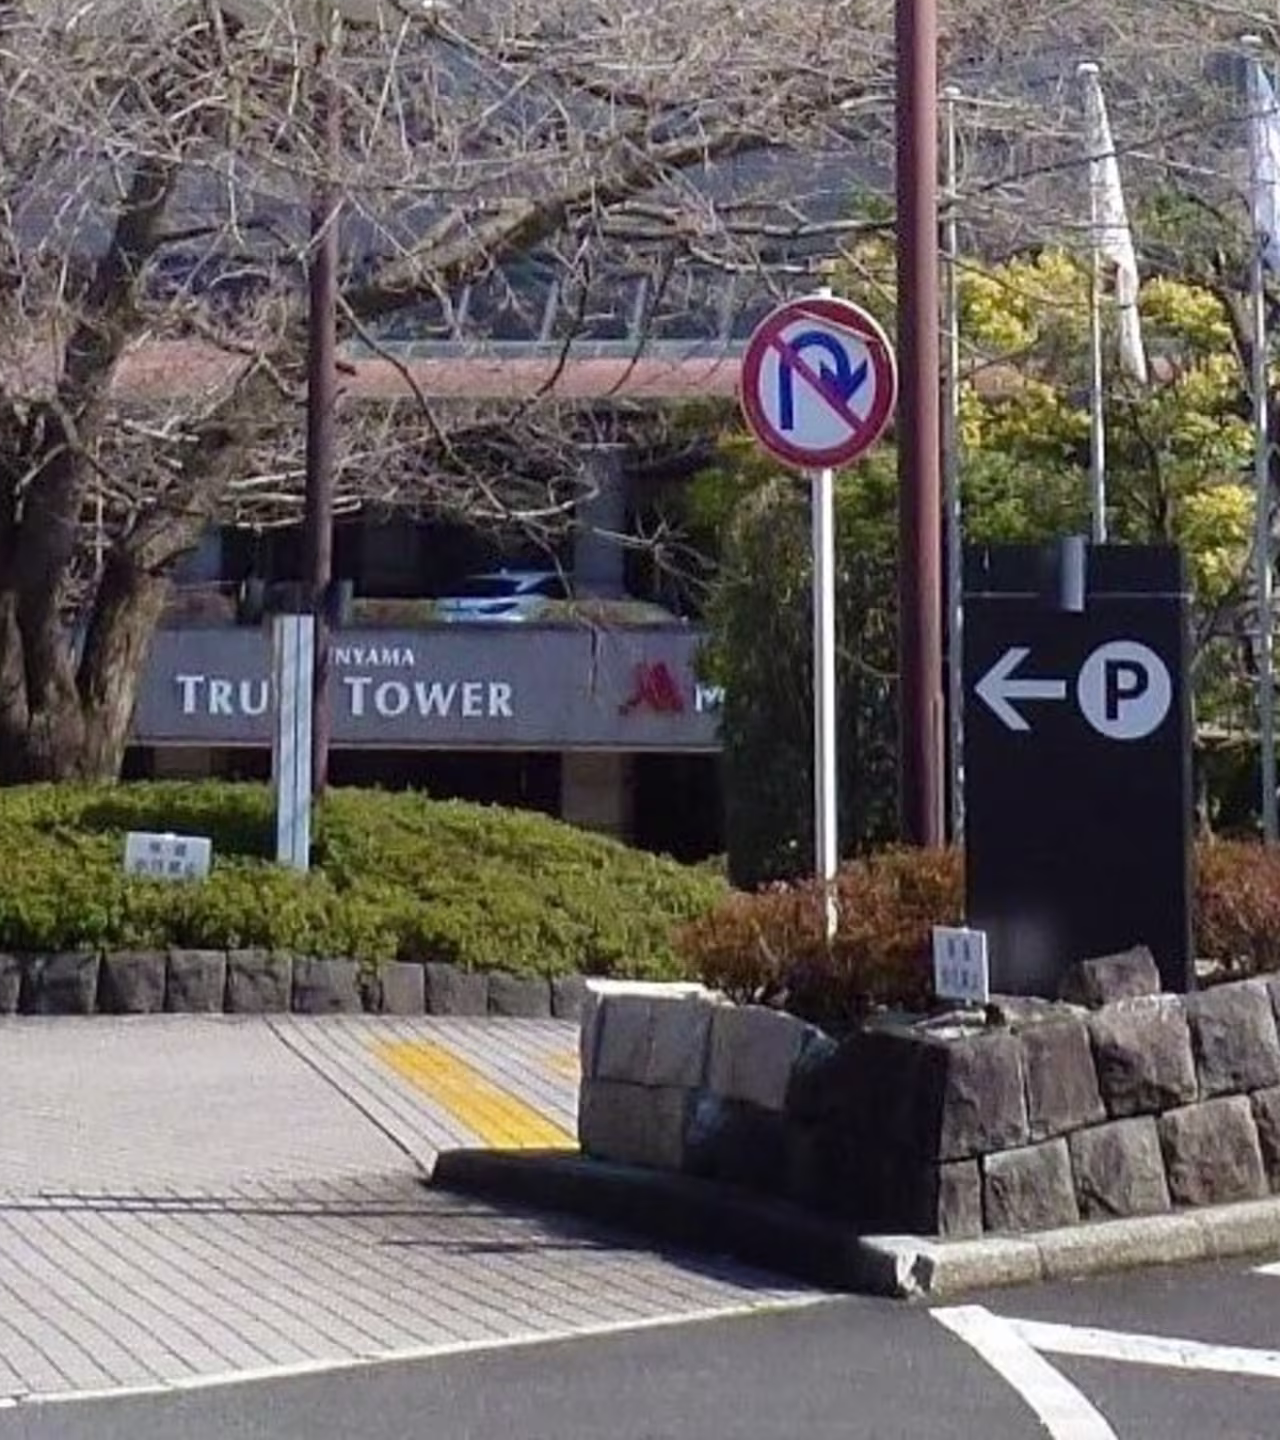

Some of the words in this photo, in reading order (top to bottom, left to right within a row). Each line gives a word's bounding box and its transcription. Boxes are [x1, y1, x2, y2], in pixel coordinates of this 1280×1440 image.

[331, 647, 416, 666] NYAMA
[176, 675, 269, 715] TRU
[343, 676, 514, 717] TOWER
